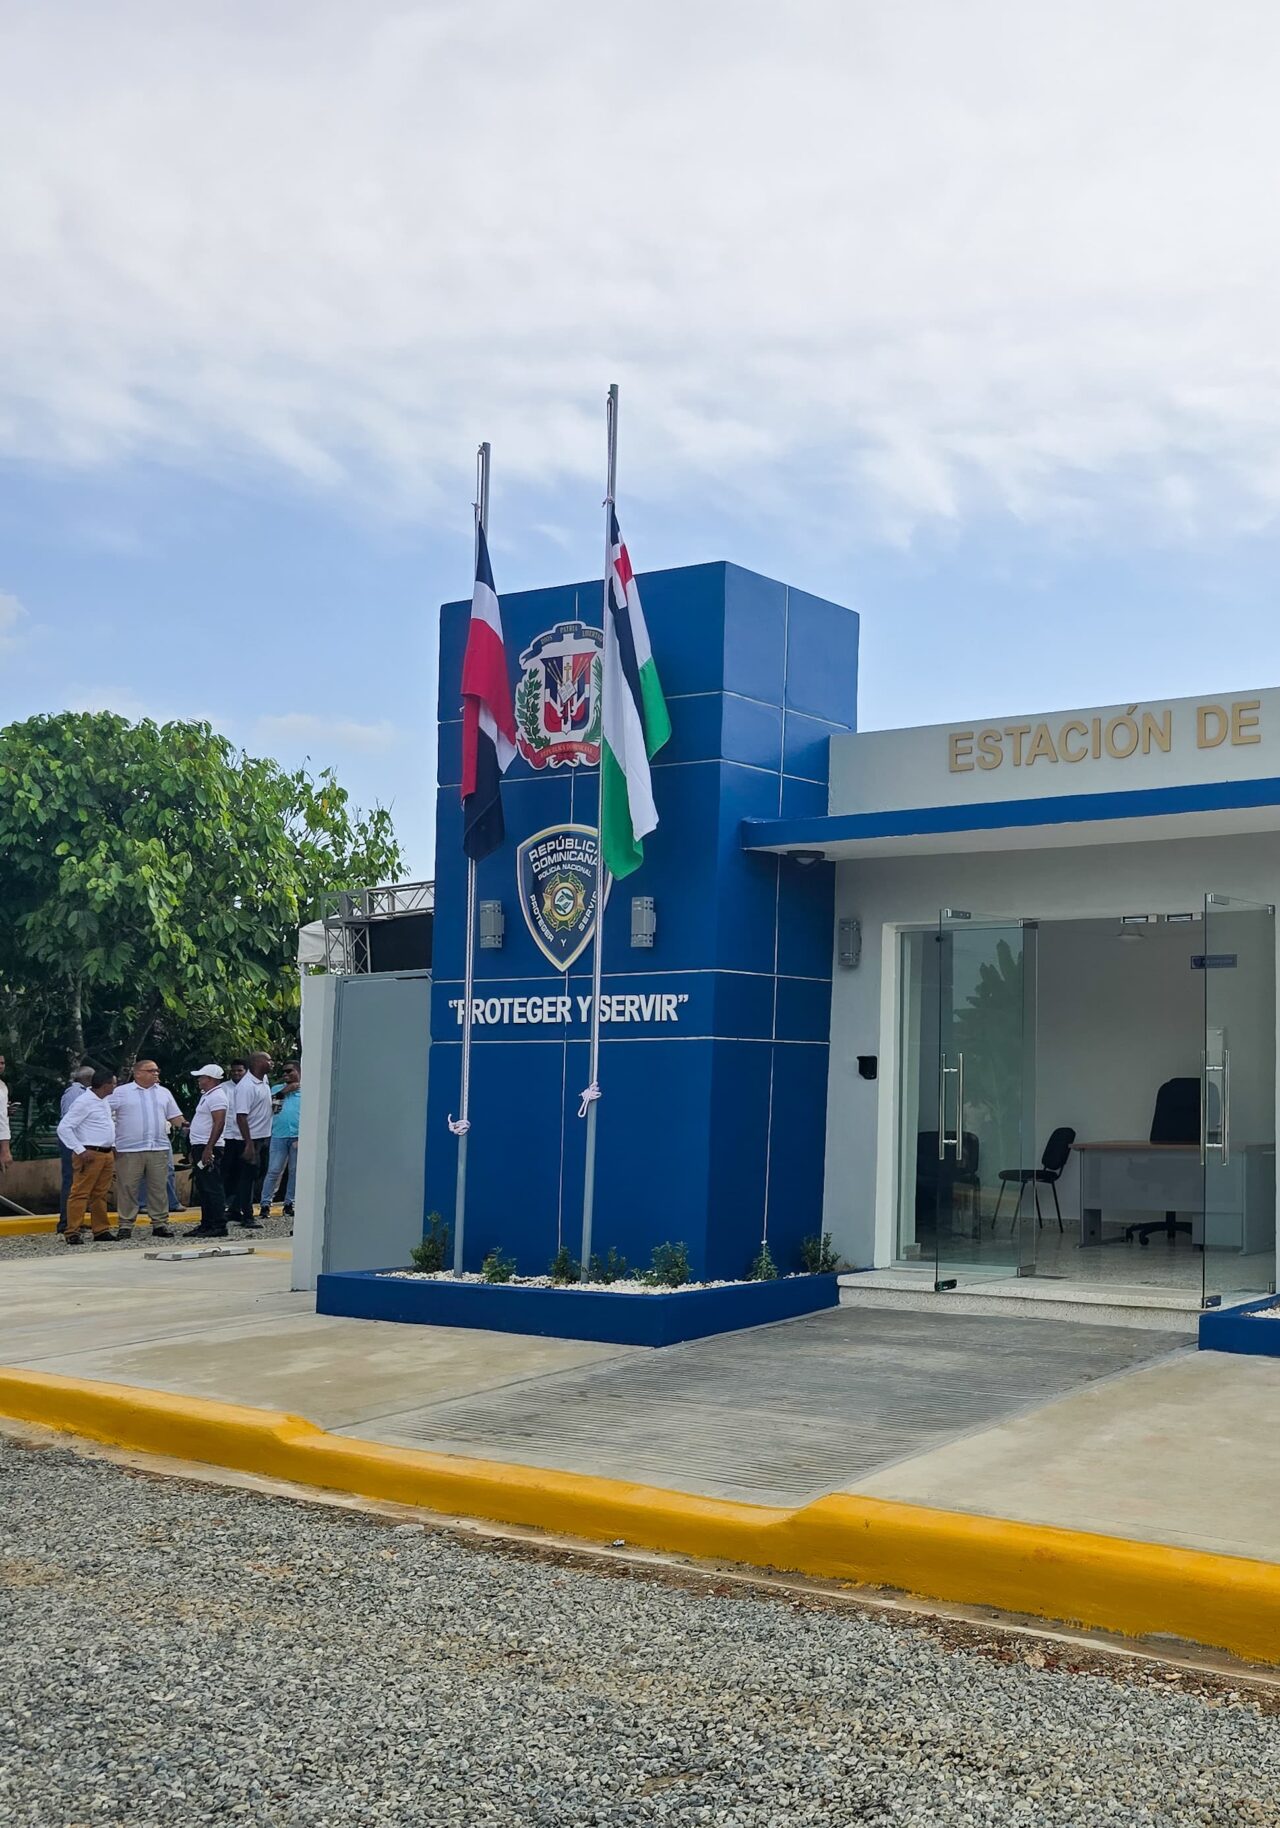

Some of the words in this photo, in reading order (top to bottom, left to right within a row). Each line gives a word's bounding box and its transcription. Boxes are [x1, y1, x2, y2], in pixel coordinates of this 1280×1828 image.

[949, 704, 1172, 772] ESTACIÓN
[1197, 700, 1261, 749] DE
[529, 835, 597, 862] REPÚBLIC
[562, 863, 592, 877] NACIONAL
[529, 894, 554, 942] PROTEGER
[560, 938, 567, 947] Y
[577, 995, 592, 1023] Y
